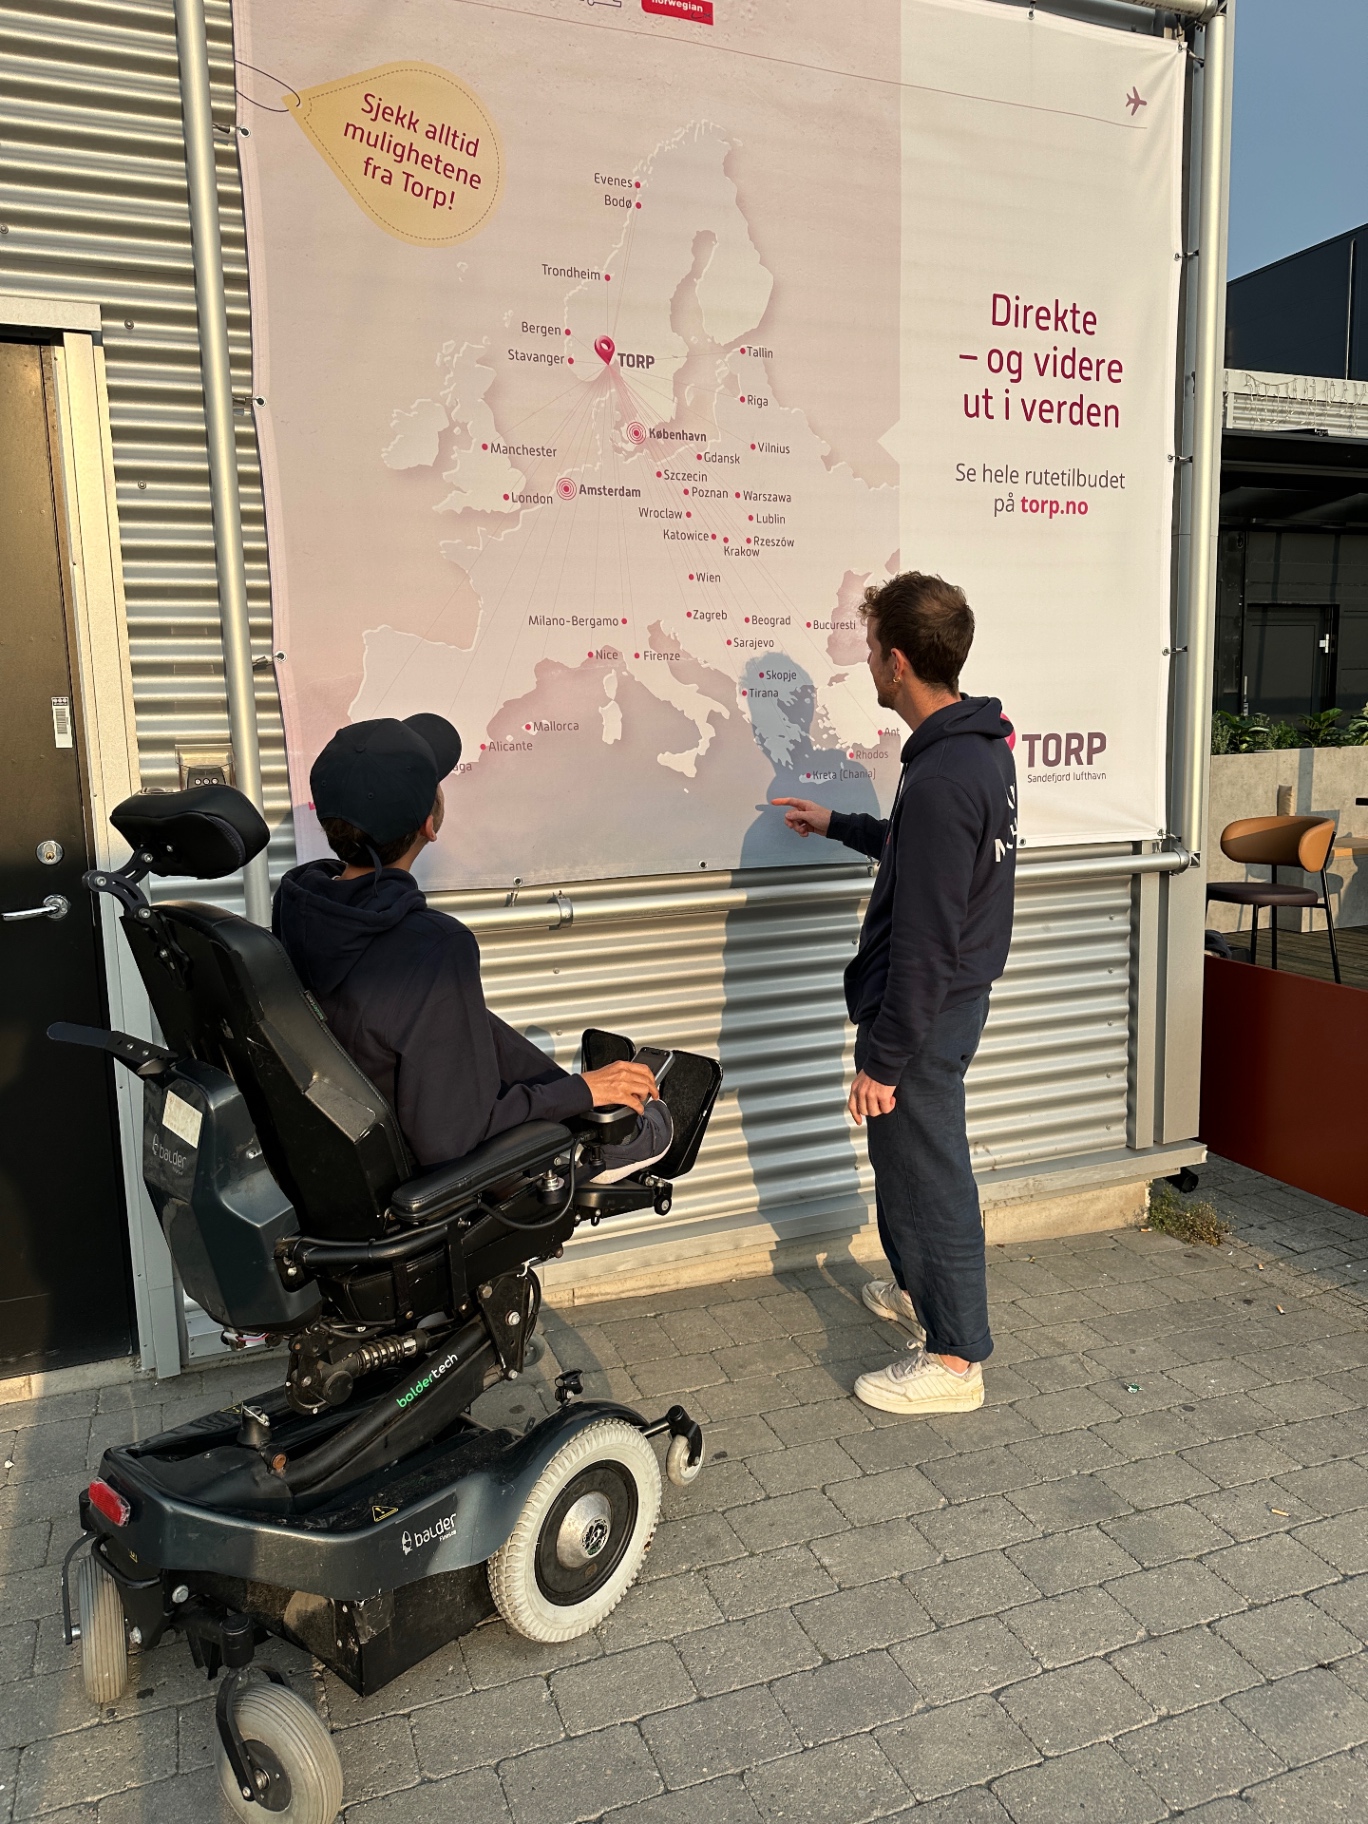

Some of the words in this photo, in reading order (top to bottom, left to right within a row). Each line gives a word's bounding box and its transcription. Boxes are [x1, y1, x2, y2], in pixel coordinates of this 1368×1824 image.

[361, 93, 420, 133] Sjekk
[425, 123, 480, 158] alltid
[343, 122, 482, 190] mulighetene
[363, 156, 394, 186] fra
[402, 170, 455, 211] Torp!
[594, 172, 633, 188] Evenes
[604, 194, 633, 209] Bodø
[541, 263, 601, 281] Trondheim
[991, 293, 1097, 336] Direkte
[521, 321, 562, 338] Bergen
[508, 349, 565, 367] Stavanger
[747, 346, 773, 359] Tallin
[617, 352, 655, 369] TORP
[987, 348, 1023, 384] og
[1034, 345, 1124, 384] videre
[747, 394, 769, 408] Riga
[963, 388, 995, 420] ut
[1004, 388, 1010, 421] i
[1020, 393, 1120, 429] verden
[649, 428, 707, 442] København
[490, 442, 557, 458] Manchester
[757, 442, 791, 454] Vilnius
[704, 451, 741, 465] Gdansk
[664, 469, 708, 482] Szczecin
[955, 462, 977, 483] Se
[982, 463, 1019, 484] hele
[1025, 467, 1126, 489] rutetilbudet
[578, 484, 641, 498] Amsterdam
[691, 486, 729, 499] Poznan
[743, 490, 792, 503] Warszawa
[511, 492, 553, 505] London
[994, 491, 1015, 517] på
[1020, 496, 1089, 519] torp.no
[638, 507, 683, 519] Wroclaw
[756, 513, 786, 525] Lublin
[663, 529, 709, 541] Katowice
[753, 536, 795, 548] Rzeszów
[723, 545, 760, 557] Krakow
[696, 572, 721, 583] Wien
[528, 615, 619, 628] Milano-Bergamo
[693, 609, 728, 622] Zagreb
[751, 615, 791, 628] Beograd
[813, 620, 856, 630] Bucuresti
[733, 637, 774, 650] Sarajevo
[595, 650, 619, 660] Nice
[643, 651, 681, 661] Firenze
[766, 670, 797, 682] Skopje
[749, 688, 779, 698] Tirana
[533, 721, 580, 732] Mallorca
[488, 740, 533, 753] Alicante
[1021, 731, 1107, 768] TORP
[855, 750, 889, 760] Rhodos
[813, 769, 837, 780] Kreta
[1027, 771, 1071, 784] Sandefjord
[1073, 771, 1107, 781] lufthavn
[159, 1143, 187, 1168] balder
[396, 1353, 459, 1408] baldertech
[414, 1512, 457, 1548] balder
